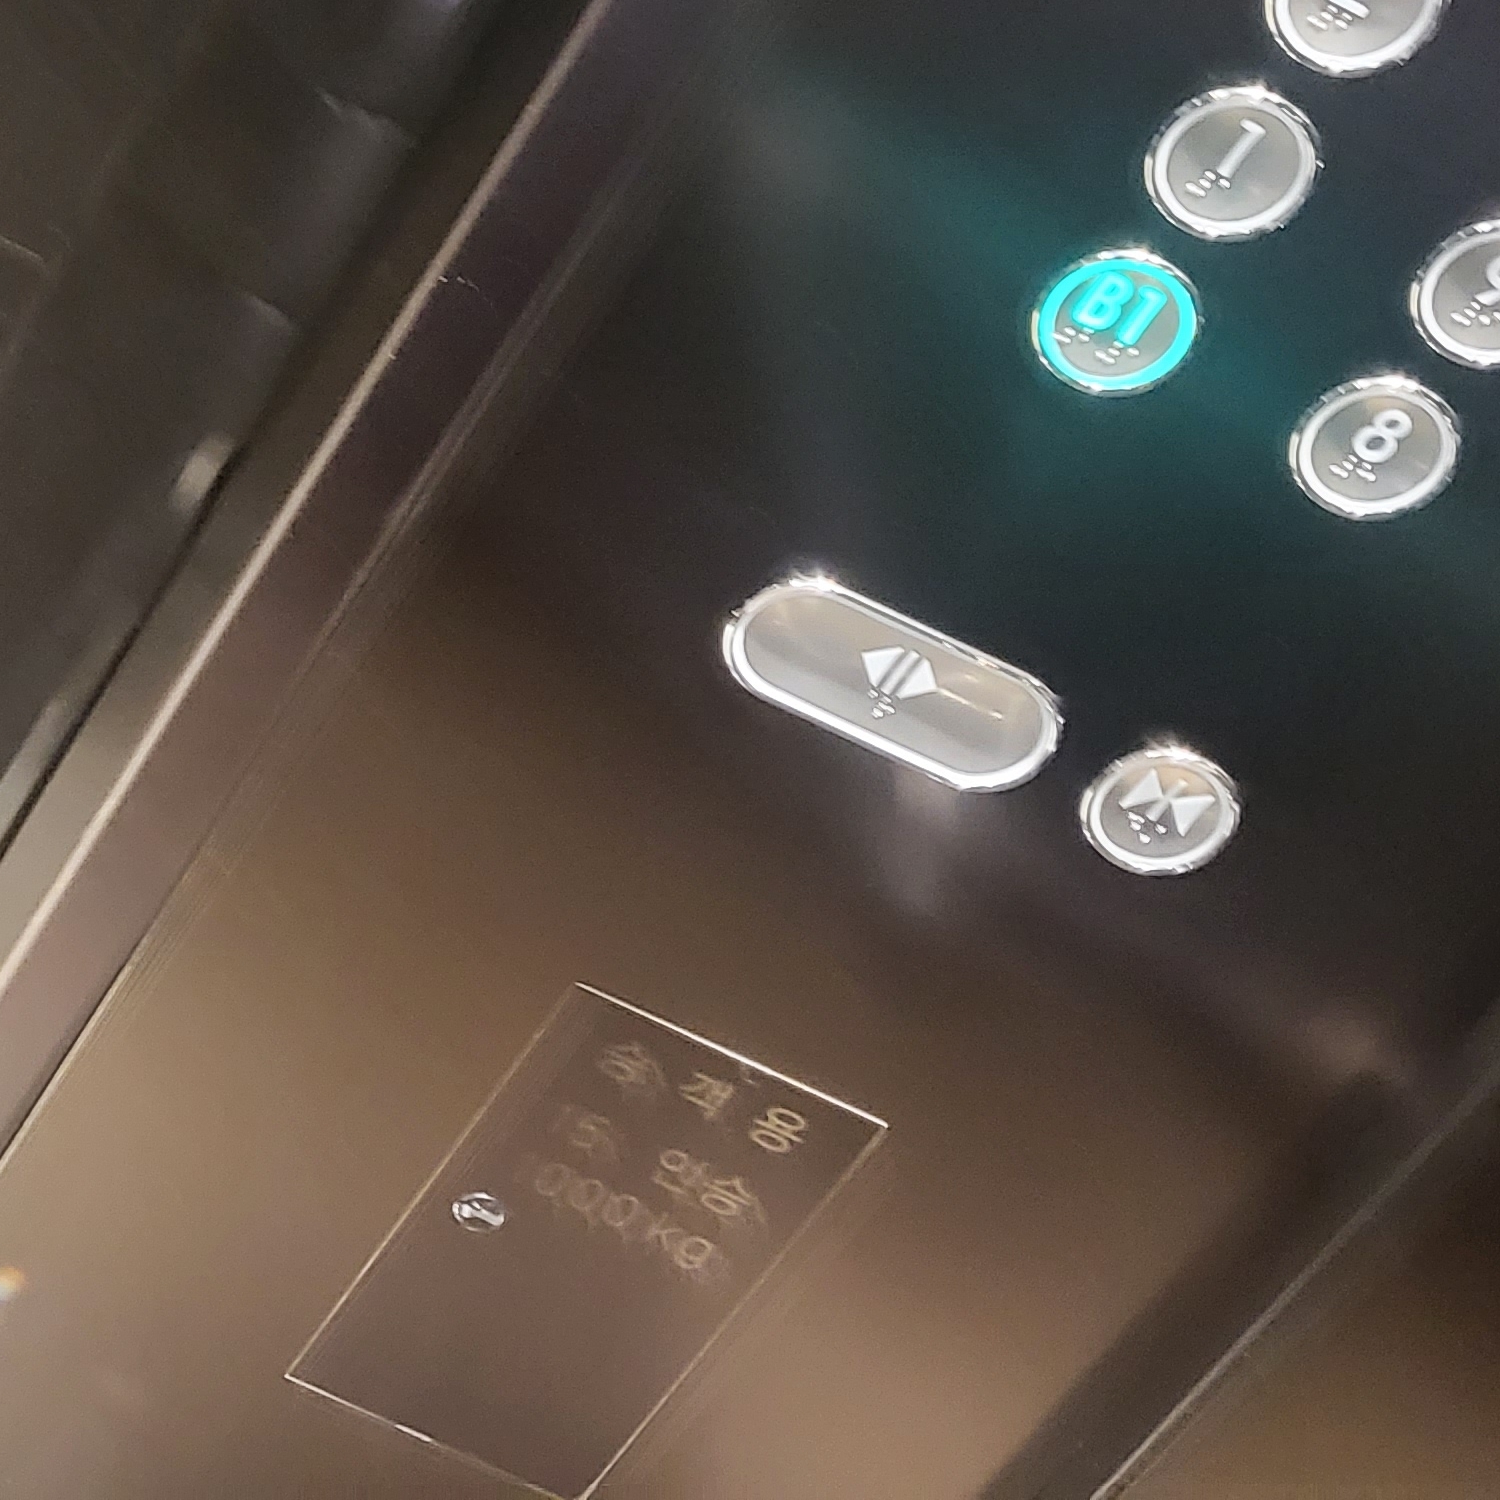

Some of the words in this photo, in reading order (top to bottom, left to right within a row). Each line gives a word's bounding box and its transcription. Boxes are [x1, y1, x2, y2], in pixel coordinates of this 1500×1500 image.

[1215, 118, 1268, 183] 1
[1071, 270, 1169, 348] B1
[1350, 408, 1413, 465] 8
